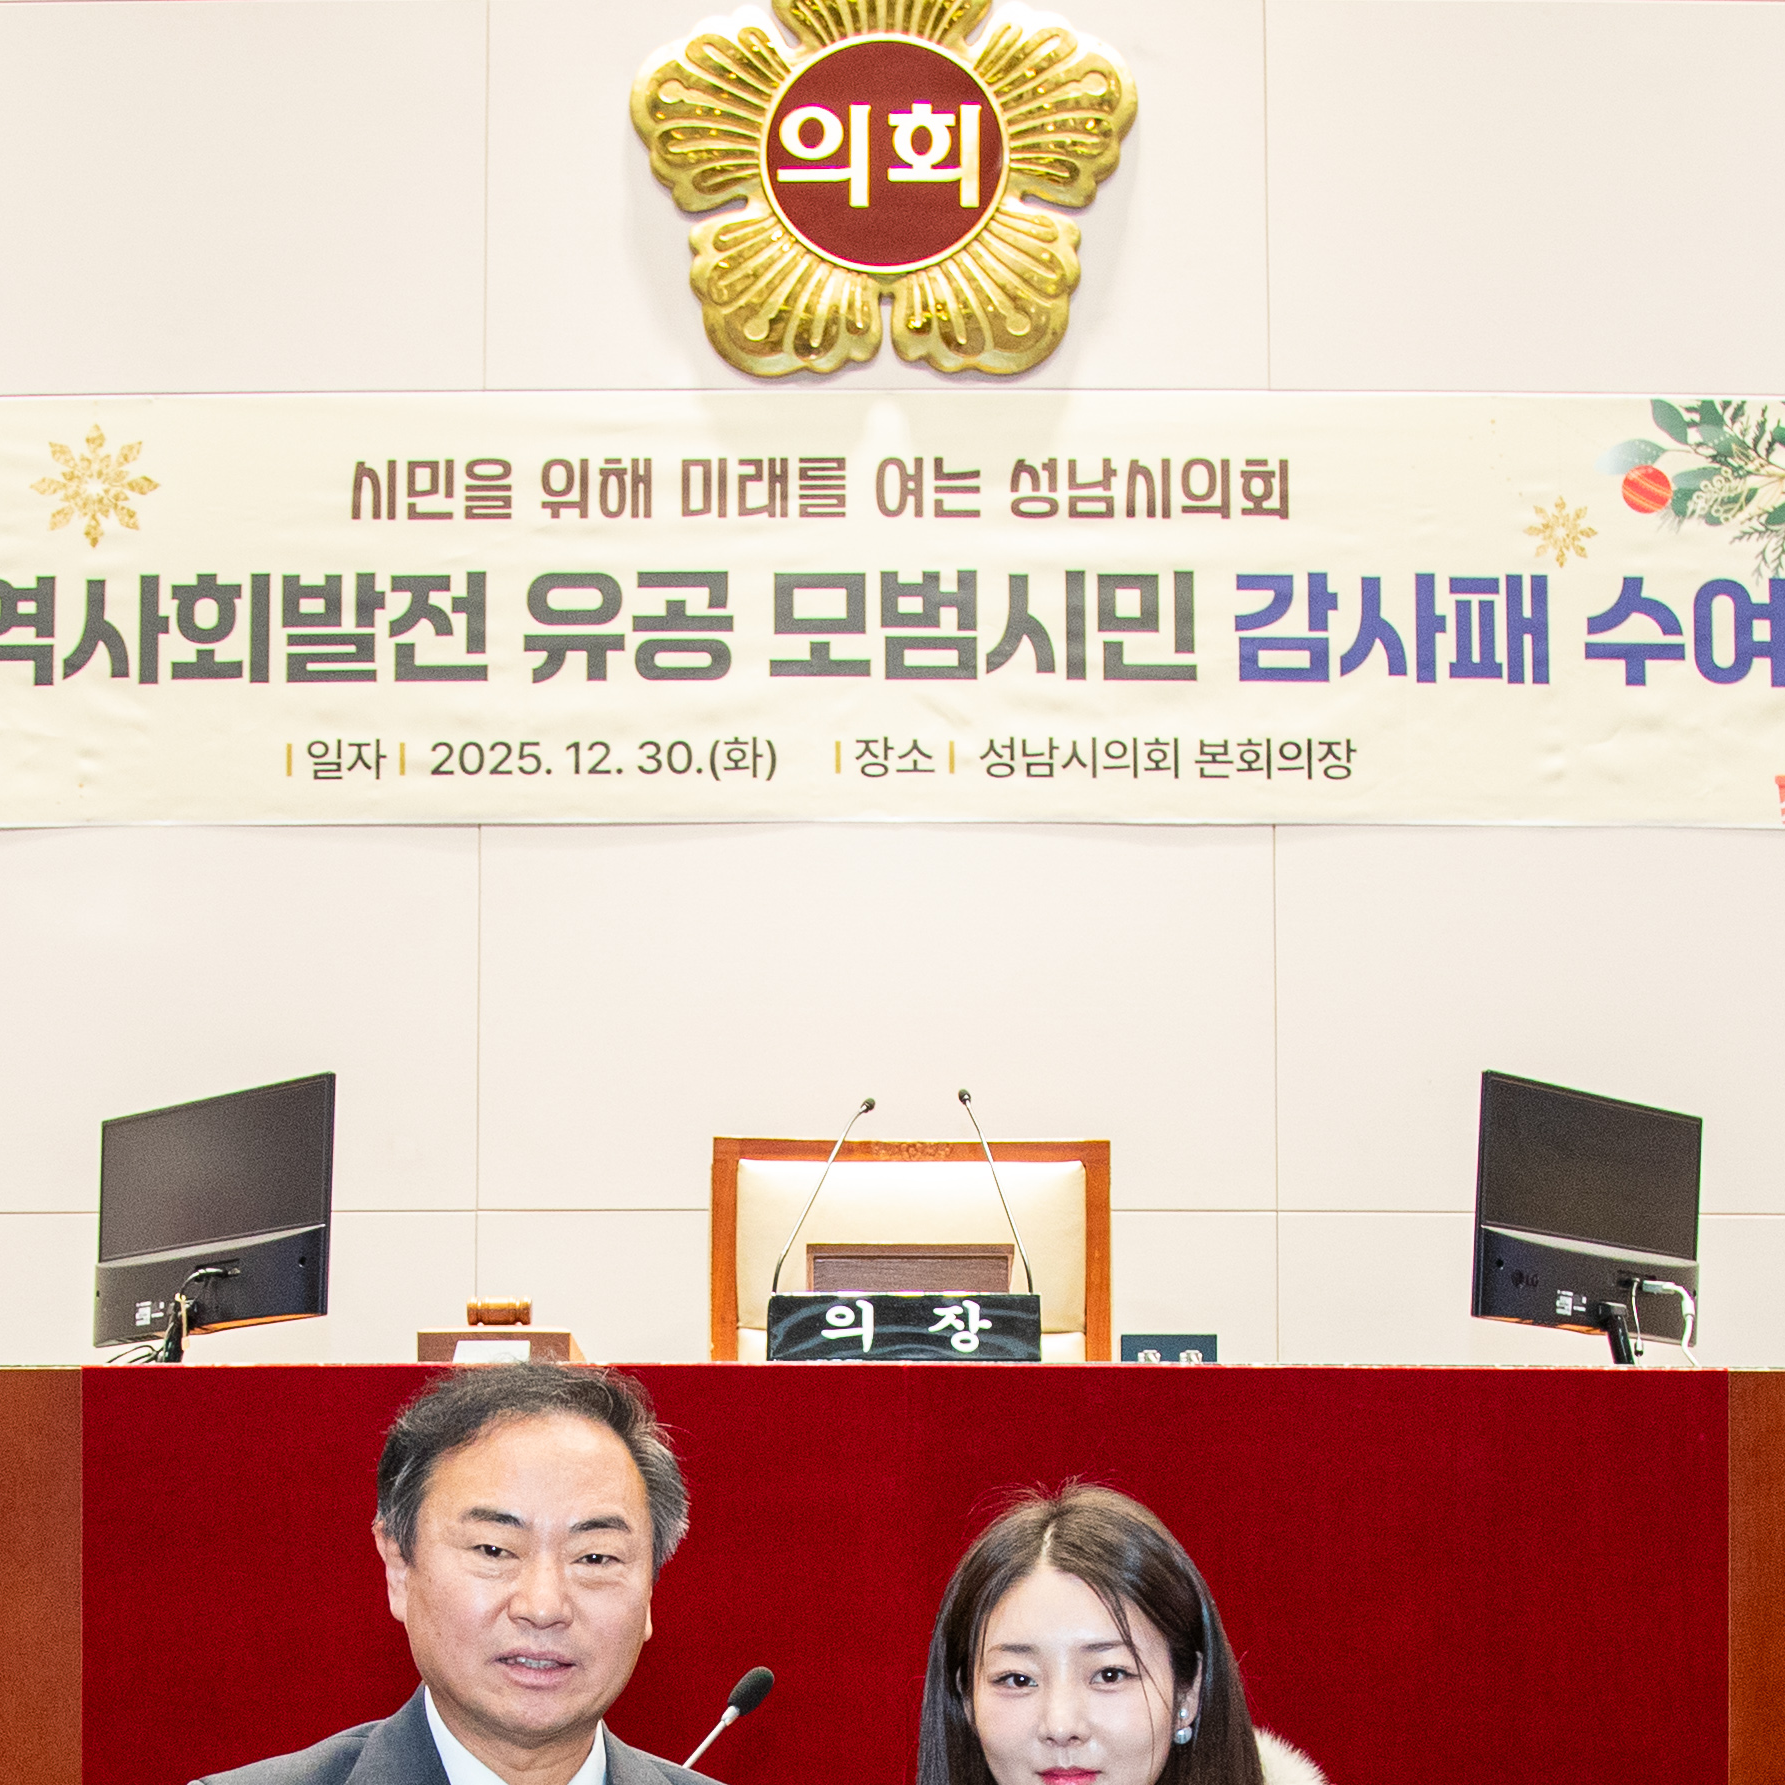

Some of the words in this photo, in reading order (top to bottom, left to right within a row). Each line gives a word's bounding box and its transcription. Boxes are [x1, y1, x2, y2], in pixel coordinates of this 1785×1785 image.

[776, 99, 982, 209] 의회
[350, 457, 512, 521] 시민을
[540, 457, 652, 520] 위해
[681, 456, 847, 519] 미래를
[875, 456, 981, 519] 여는
[1010, 457, 1290, 520] 성남시의회
[523, 570, 734, 684] 유공
[769, 569, 1198, 682] 모범시민
[1233, 570, 1552, 685] 감사패
[306, 738, 387, 780] 일자
[429, 740, 553, 776] 2025.
[565, 740, 623, 775] 12.
[636, 736, 779, 783] 30.(화)
[855, 736, 936, 778] 장소
[979, 736, 1181, 780] 성남시의회
[1194, 737, 1357, 781] 본회의장
